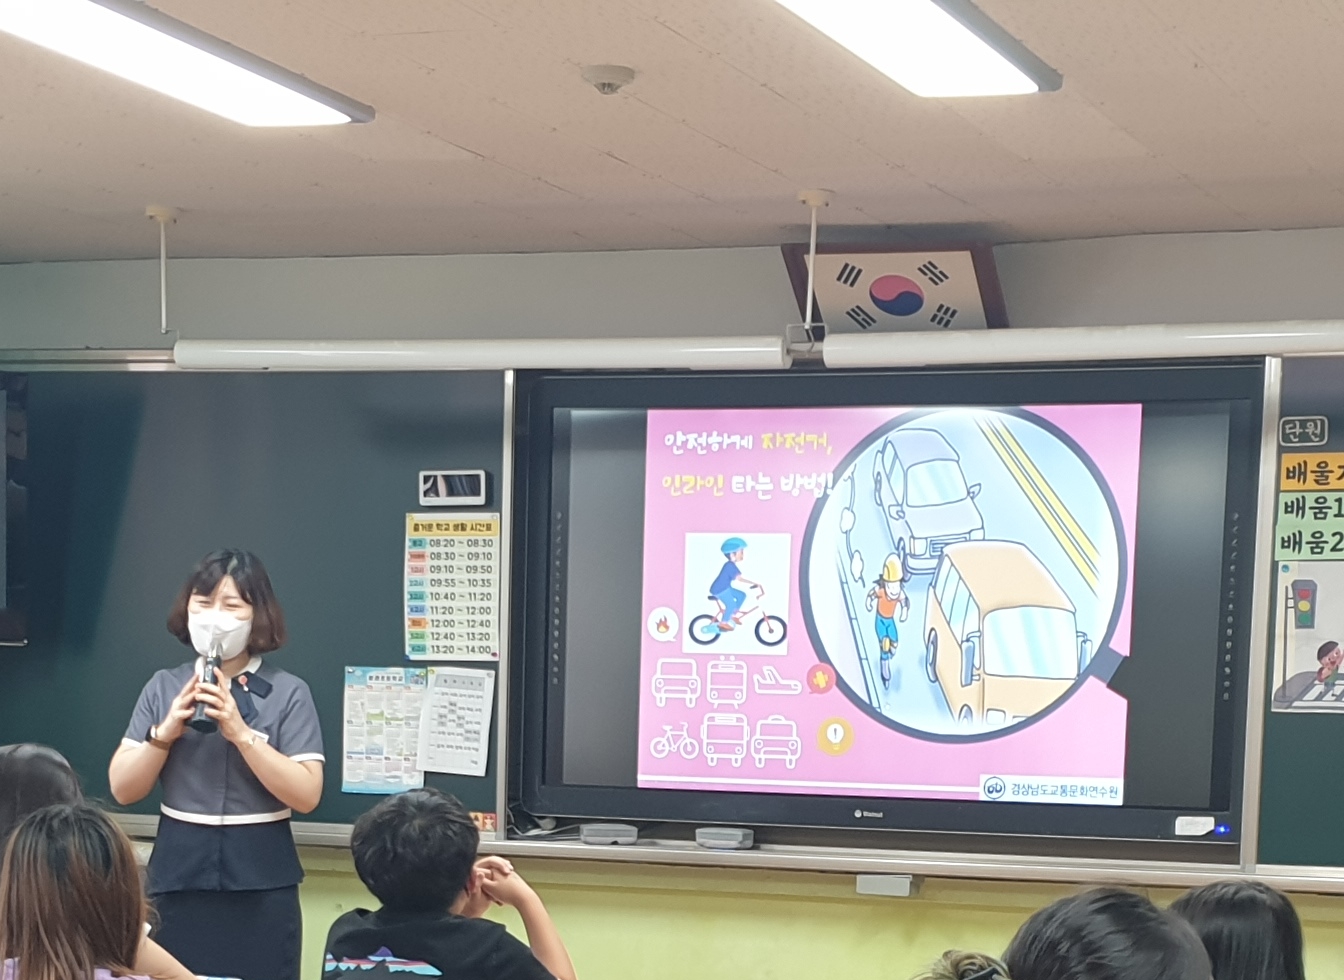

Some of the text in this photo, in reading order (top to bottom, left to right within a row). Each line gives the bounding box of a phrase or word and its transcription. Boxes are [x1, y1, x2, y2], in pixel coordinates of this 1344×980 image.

[1284, 419, 1322, 442] 단원
[664, 430, 833, 455] 안전하게 자전거,
[662, 471, 834, 500] 인라인 타는 방법!
[435, 522, 451, 532] 학교
[469, 522, 492, 532] 시간표
[429, 539, 455, 548] 08:20
[466, 539, 494, 548] 08:30
[1280, 529, 1344, 555] 배움2
[429, 552, 456, 561] 08:30
[467, 552, 493, 561] 09:10
[429, 565, 455, 574] 09:10
[465, 565, 493, 574] 09:50
[430, 578, 456, 587] 09:55
[467, 578, 492, 587] 10:35
[430, 592, 456, 601] 10:40
[468, 592, 492, 601] 11:20
[430, 606, 454, 615] 11:20
[466, 606, 492, 615] 12:00
[431, 619, 456, 628] 12:00
[466, 619, 491, 628] 12:40
[431, 632, 456, 641] 12:40
[466, 632, 491, 641] 13:20
[431, 645, 455, 654] 13:20
[465, 645, 492, 654] 14:00
[1011, 783, 1118, 799] 경상남도교통문화연수원
